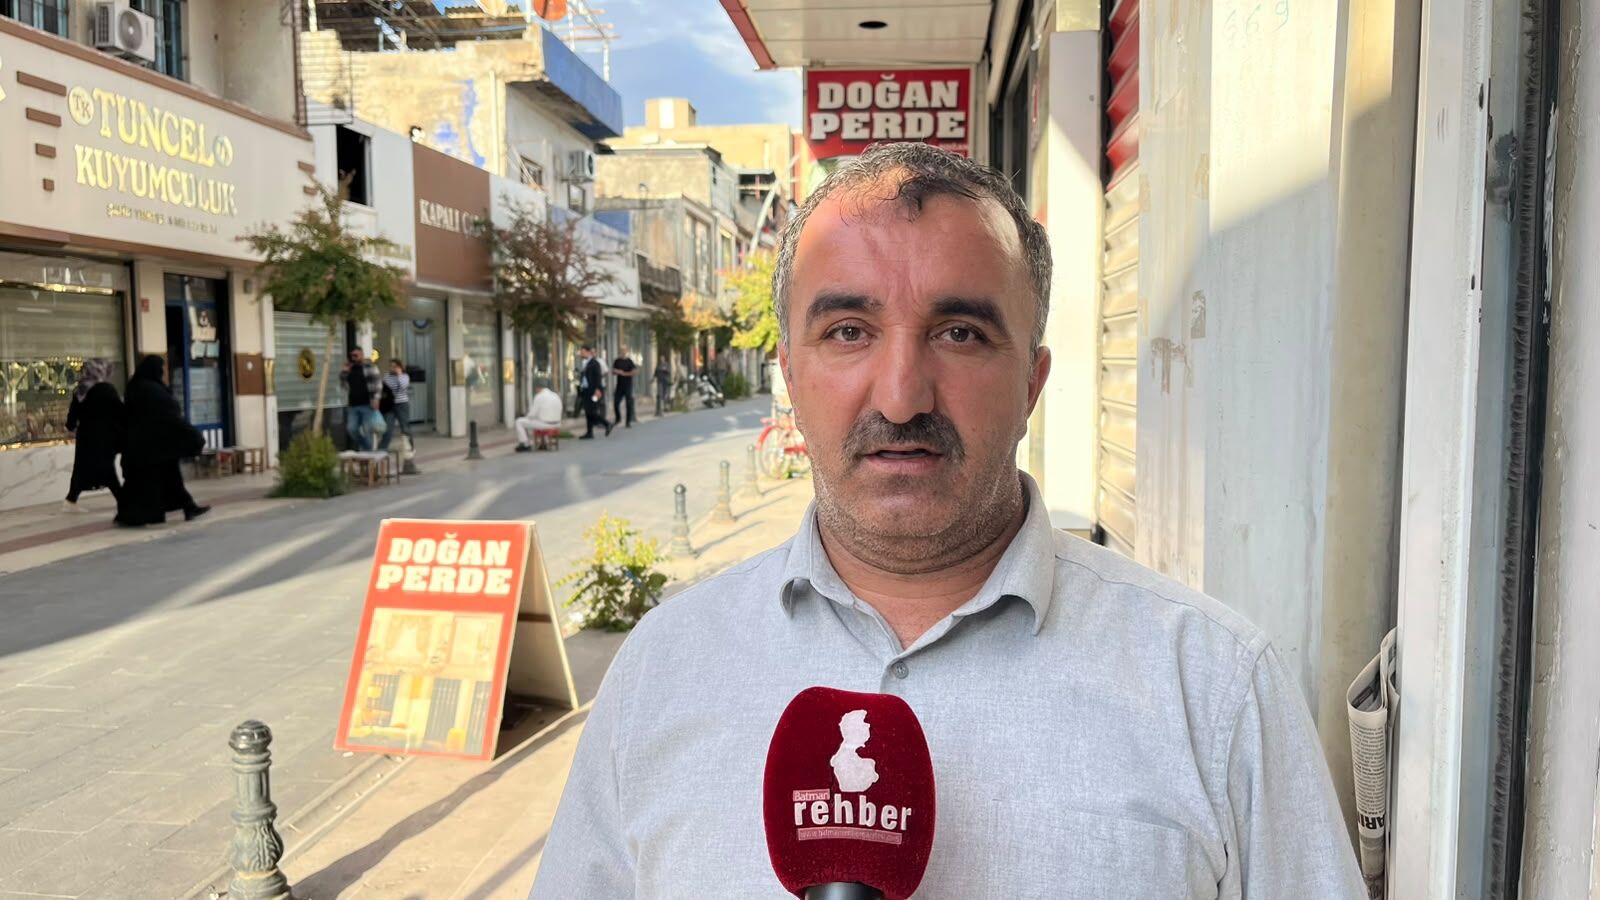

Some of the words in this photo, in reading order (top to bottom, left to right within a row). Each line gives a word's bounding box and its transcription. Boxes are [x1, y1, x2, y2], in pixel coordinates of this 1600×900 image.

[817, 74, 959, 109] DOĞAN
[93, 88, 214, 167] TUNCEL
[810, 111, 966, 140] PERDE
[75, 144, 237, 216] KUYUMCULUK
[420, 198, 460, 232] KAPALI
[389, 533, 511, 565] DOĞAN
[377, 565, 512, 594] PERDE
[794, 791, 829, 801] Batman
[794, 793, 912, 830] rehber
